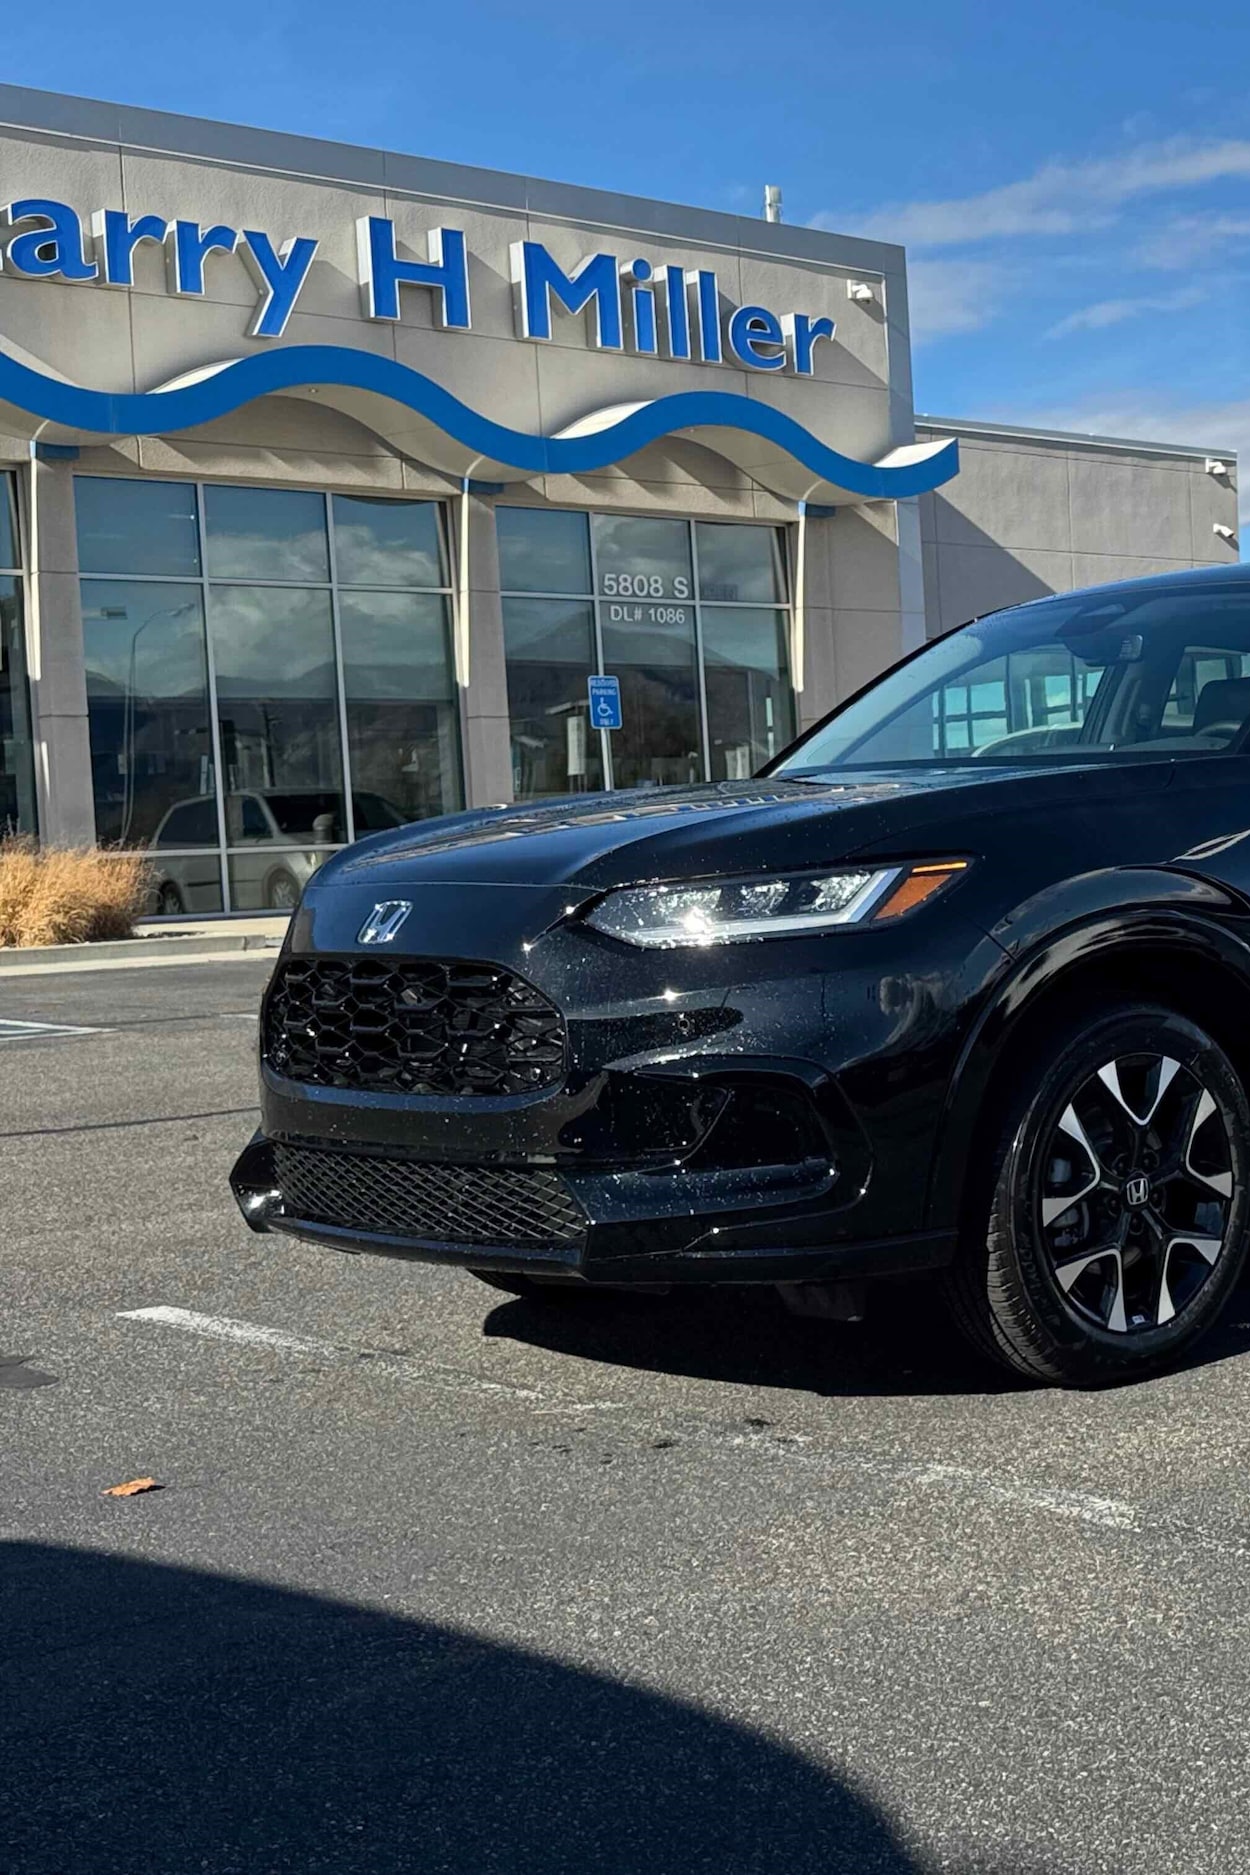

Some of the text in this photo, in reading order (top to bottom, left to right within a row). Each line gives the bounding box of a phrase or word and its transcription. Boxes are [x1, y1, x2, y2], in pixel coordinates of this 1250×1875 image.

[0, 198, 836, 376] arry H Miller
[603, 573, 689, 599] 5808 S
[610, 605, 685, 624] DL# 1086
